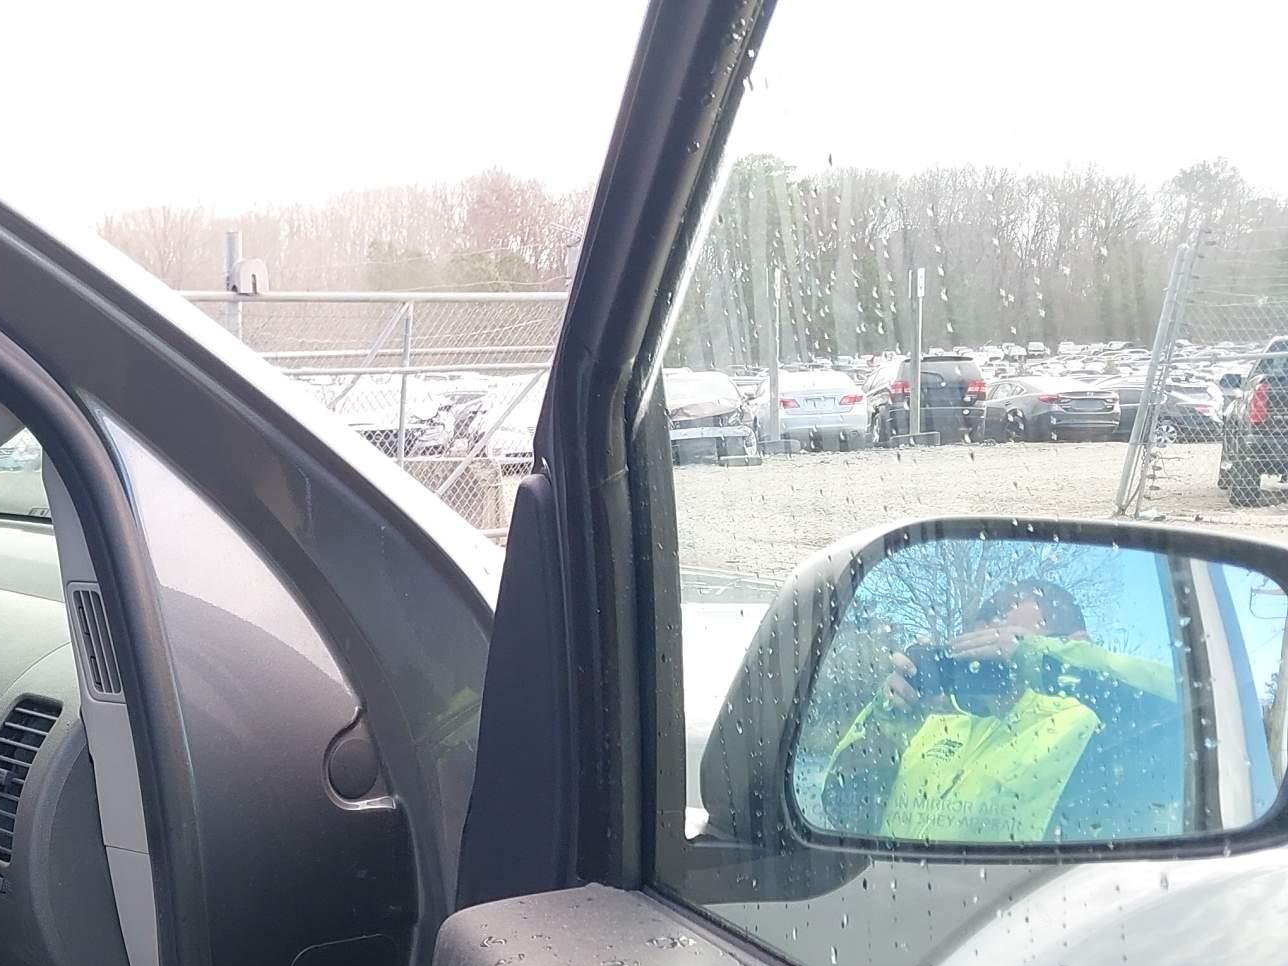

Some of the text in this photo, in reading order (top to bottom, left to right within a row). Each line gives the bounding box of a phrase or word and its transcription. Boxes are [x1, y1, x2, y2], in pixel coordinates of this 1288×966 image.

[913, 799, 973, 813] MIRROR
[979, 802, 1010, 815] ARE
[917, 812, 953, 827] THEY
[958, 814, 1022, 832] APPEAR
